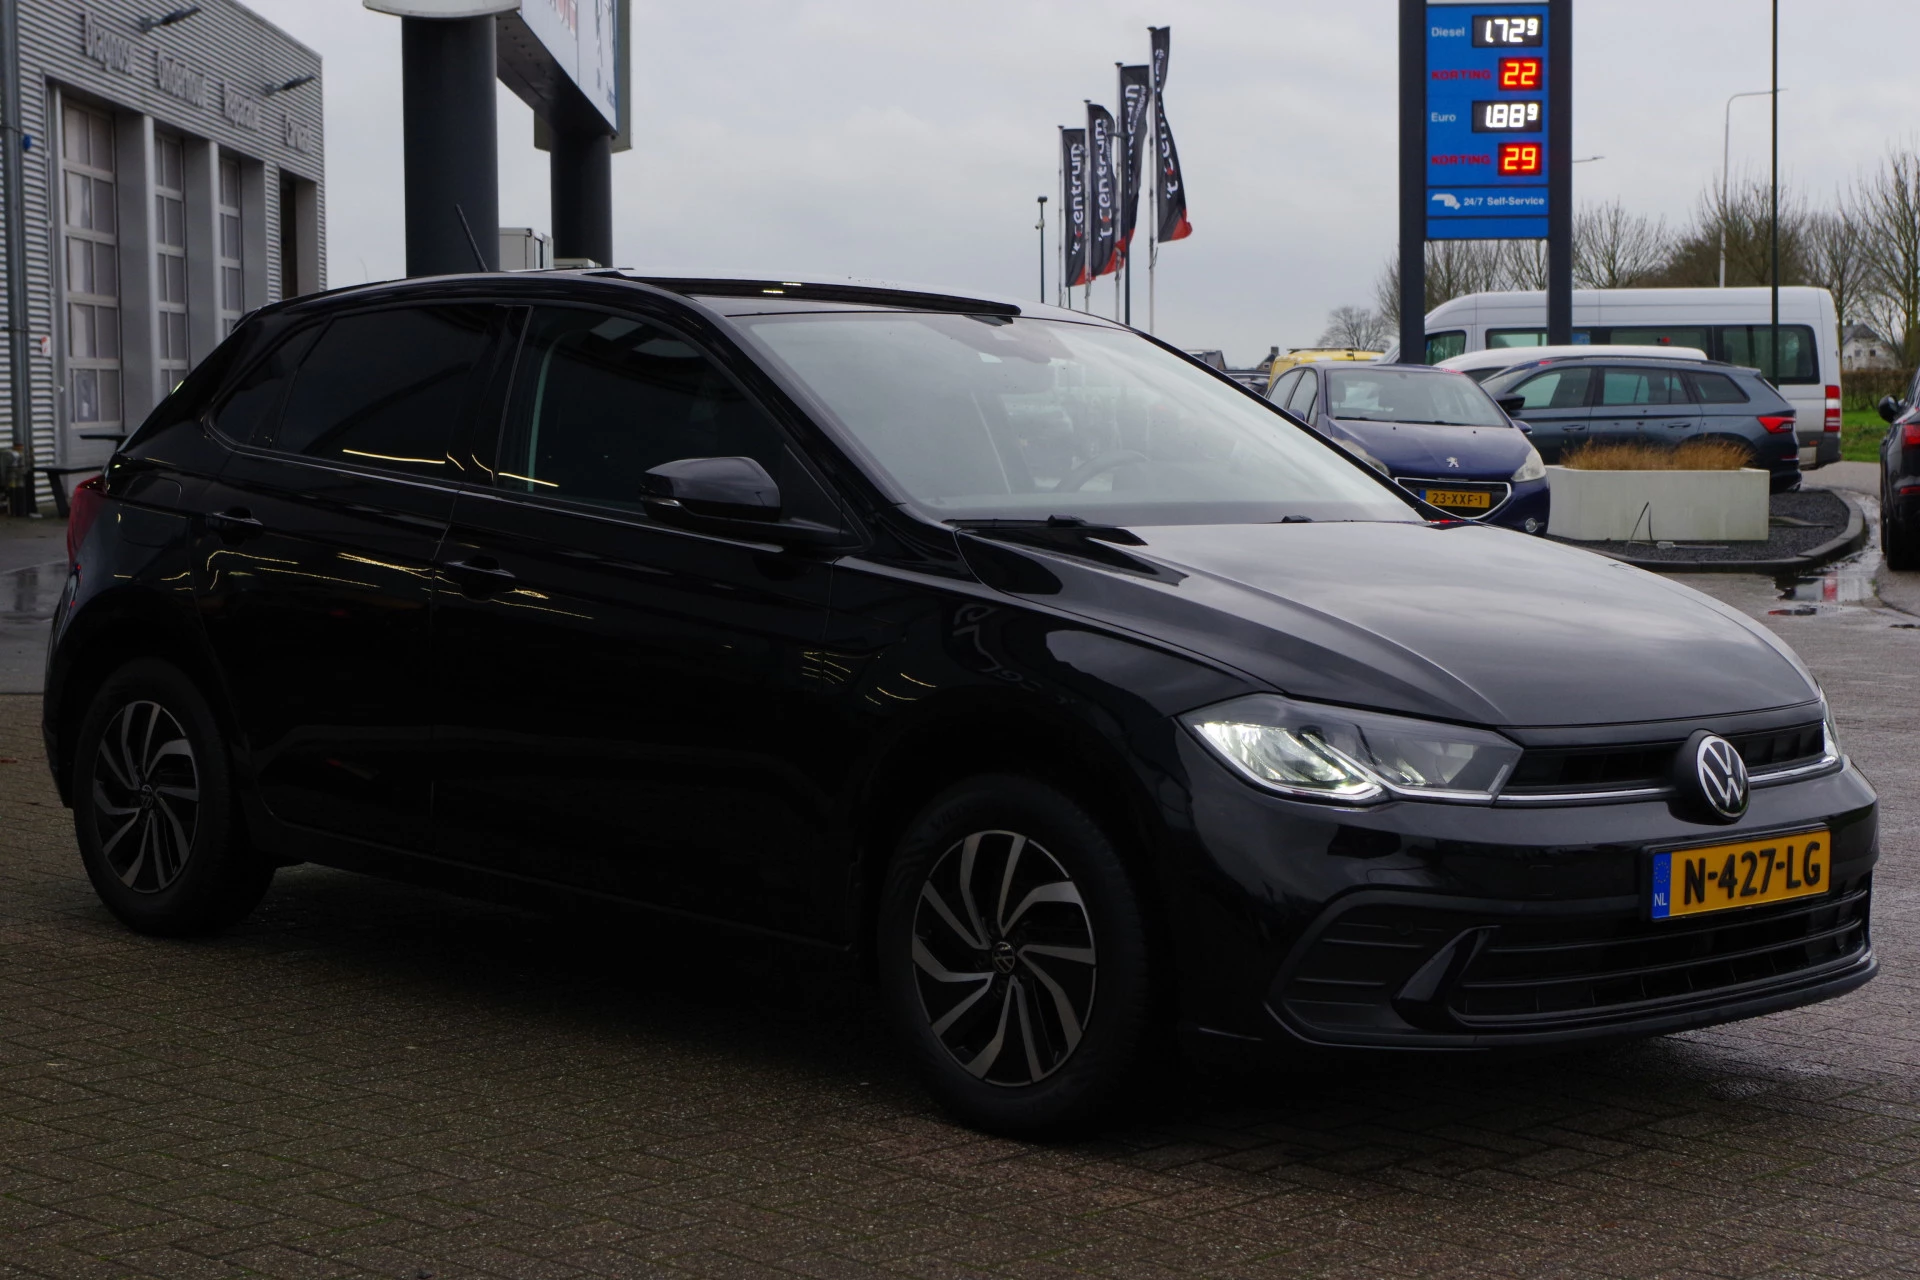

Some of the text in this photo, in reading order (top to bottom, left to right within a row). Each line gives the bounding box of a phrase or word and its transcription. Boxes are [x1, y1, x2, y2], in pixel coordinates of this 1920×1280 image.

[1431, 27, 1465, 37] Diesel
[1431, 62, 1537, 85] KORTING 22
[1431, 112, 1456, 122] Euro
[1431, 147, 1537, 171] KORTING 29
[1464, 197, 1545, 206] 24/7 Self-Service
[1432, 493, 1482, 505] 23-XXF-1
[1654, 841, 1821, 906] NL N-427-LG
